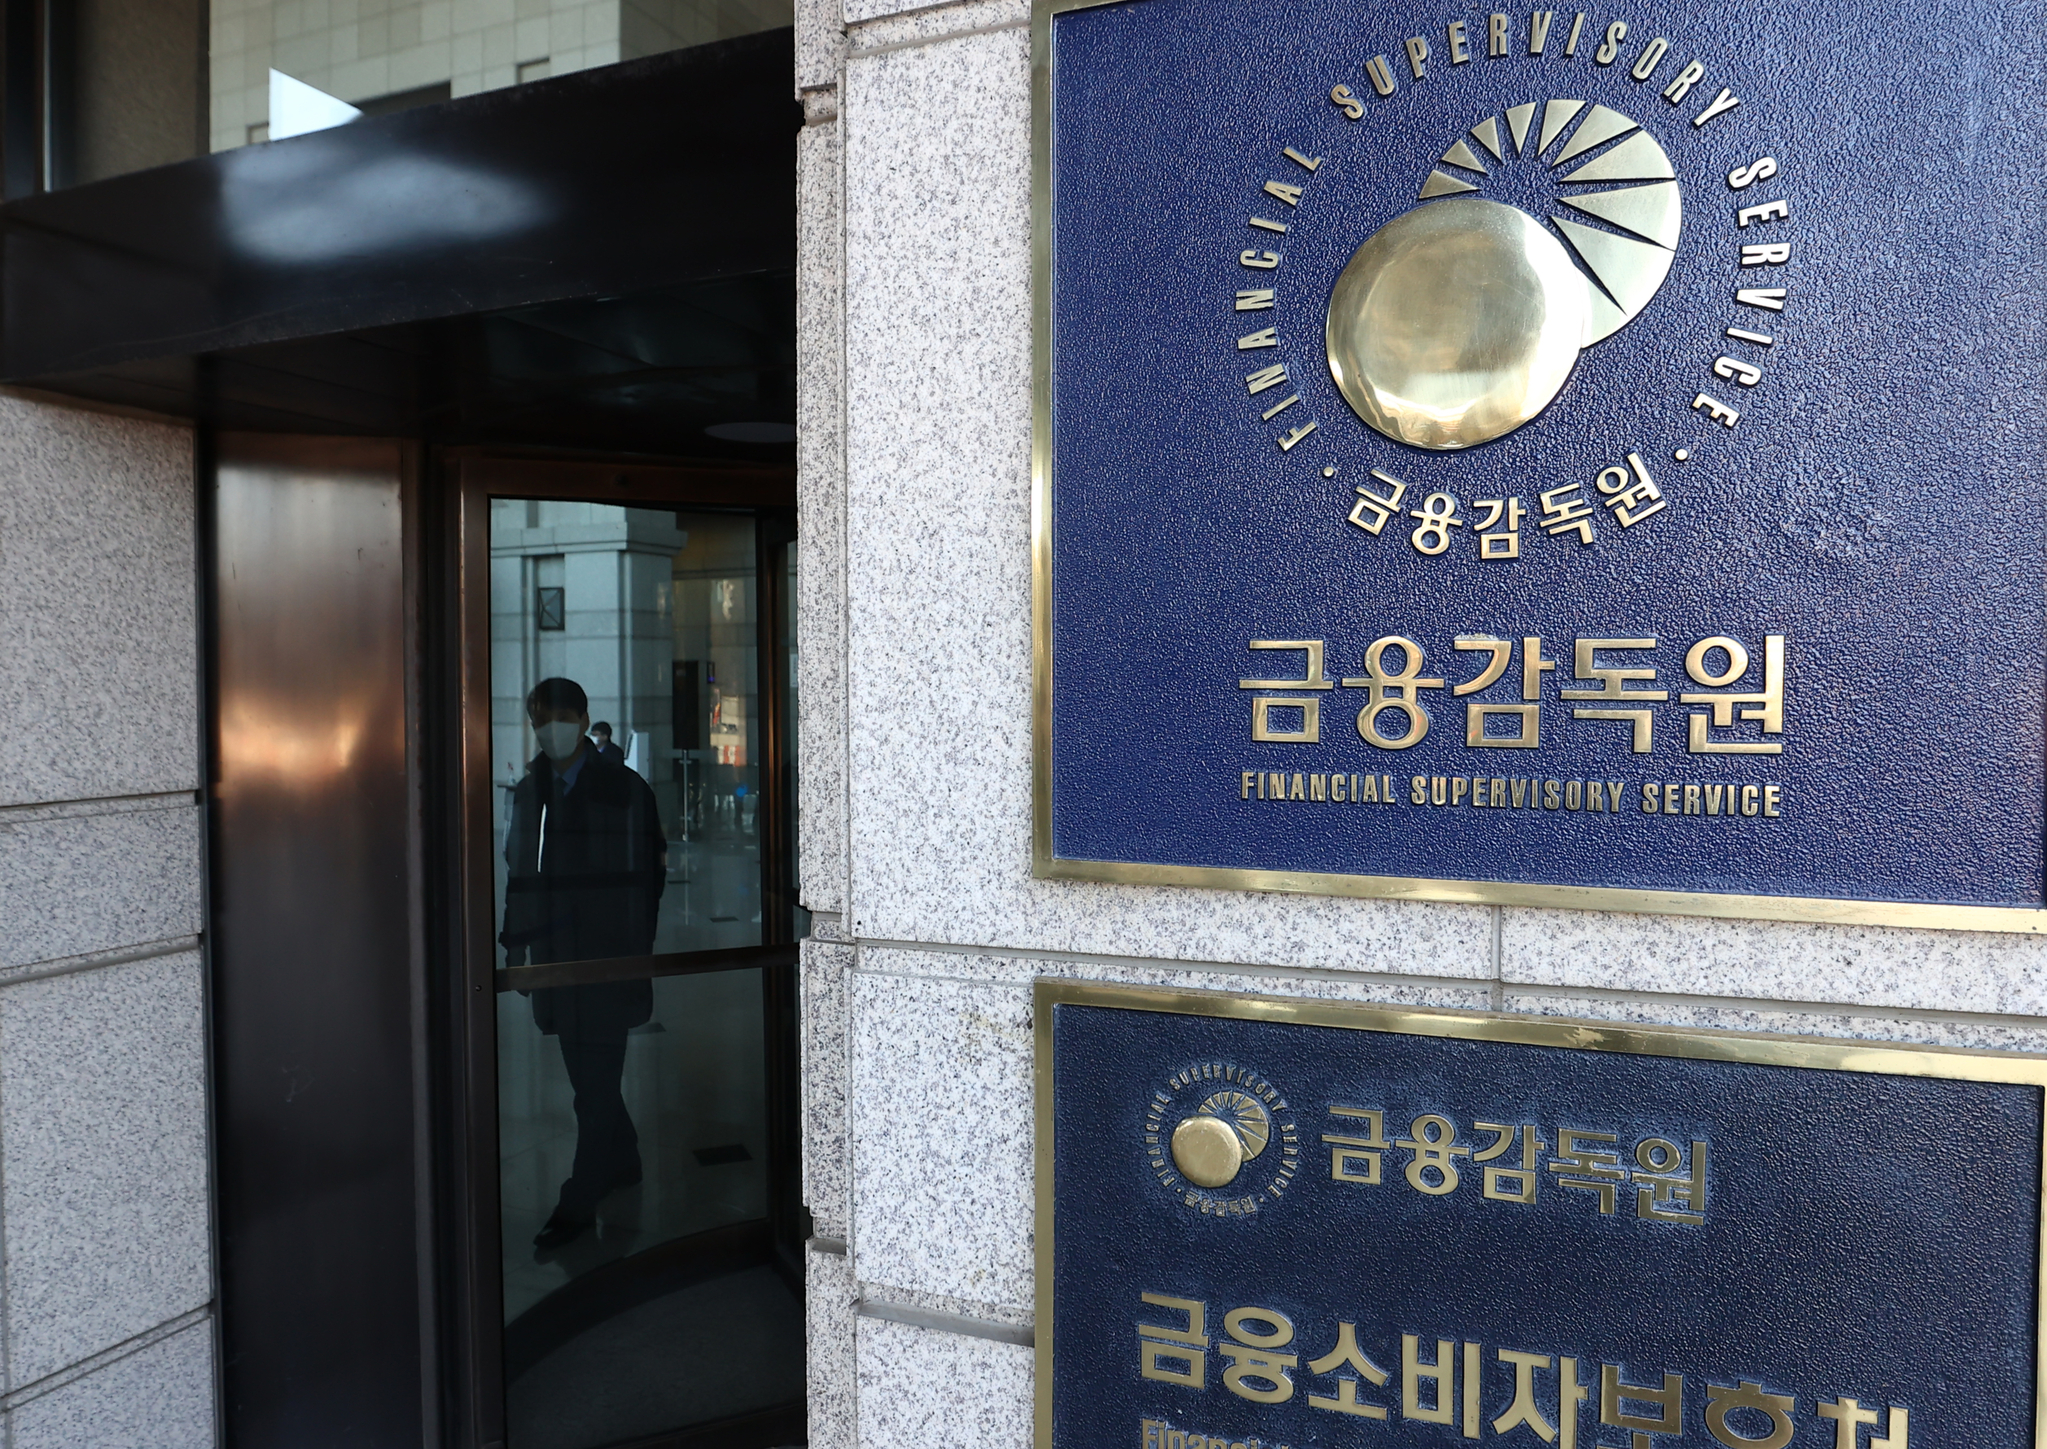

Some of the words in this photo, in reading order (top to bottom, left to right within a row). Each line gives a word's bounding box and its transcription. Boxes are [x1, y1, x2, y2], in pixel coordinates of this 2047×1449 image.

[1235, 145, 1323, 452] FINANCIAL
[1329, 11, 1739, 129] SUPERVISORY
[1692, 155, 1791, 429] SERVICE
[1346, 452, 1667, 561] 금융감독원
[1238, 634, 1786, 754] 금융감독원
[1240, 771, 1396, 806] FINANCIAL
[1410, 774, 1626, 813] SUPERVISORY
[1641, 782, 1782, 818] SERVICE
[1145, 1093, 1175, 1187] FINANCIAL
[1168, 1063, 1288, 1112] SUPERVISORY
[1267, 1123, 1299, 1198] SERVICE
[1320, 1104, 1708, 1226] 금융감독원
